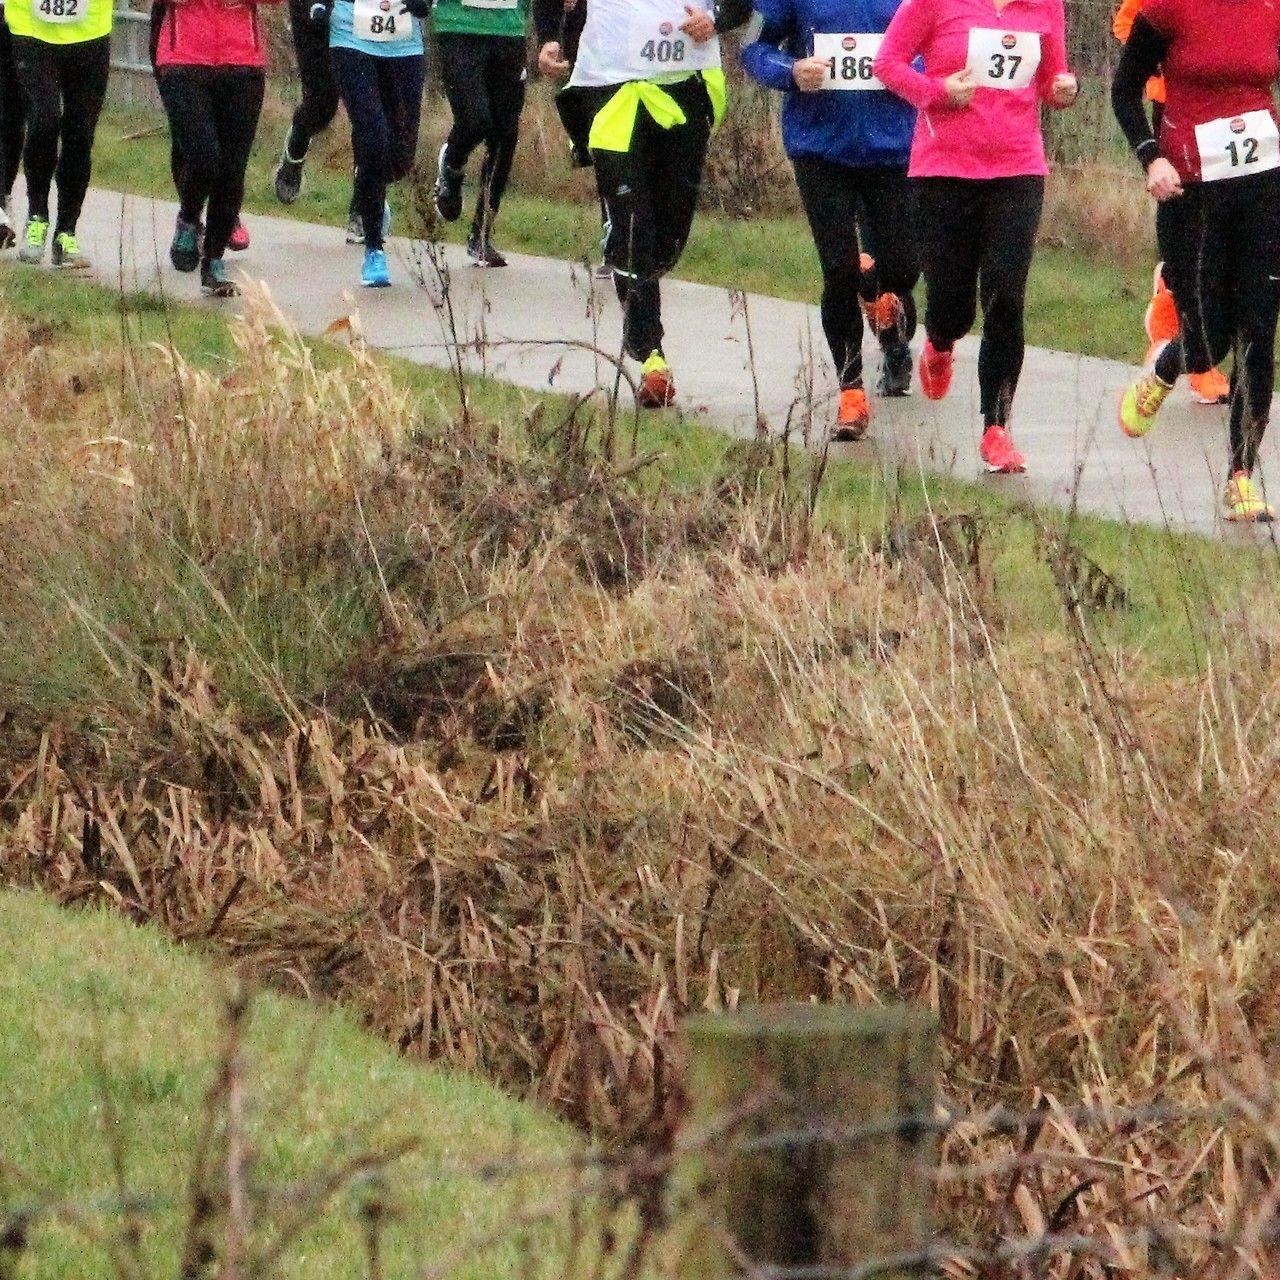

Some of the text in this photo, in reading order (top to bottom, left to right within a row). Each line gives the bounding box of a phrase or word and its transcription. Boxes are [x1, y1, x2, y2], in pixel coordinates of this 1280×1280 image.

[370, 15, 396, 34] 84
[640, 40, 685, 62] 408
[827, 56, 874, 80] 186
[988, 53, 1022, 80] 37
[1224, 137, 1259, 167] 12
